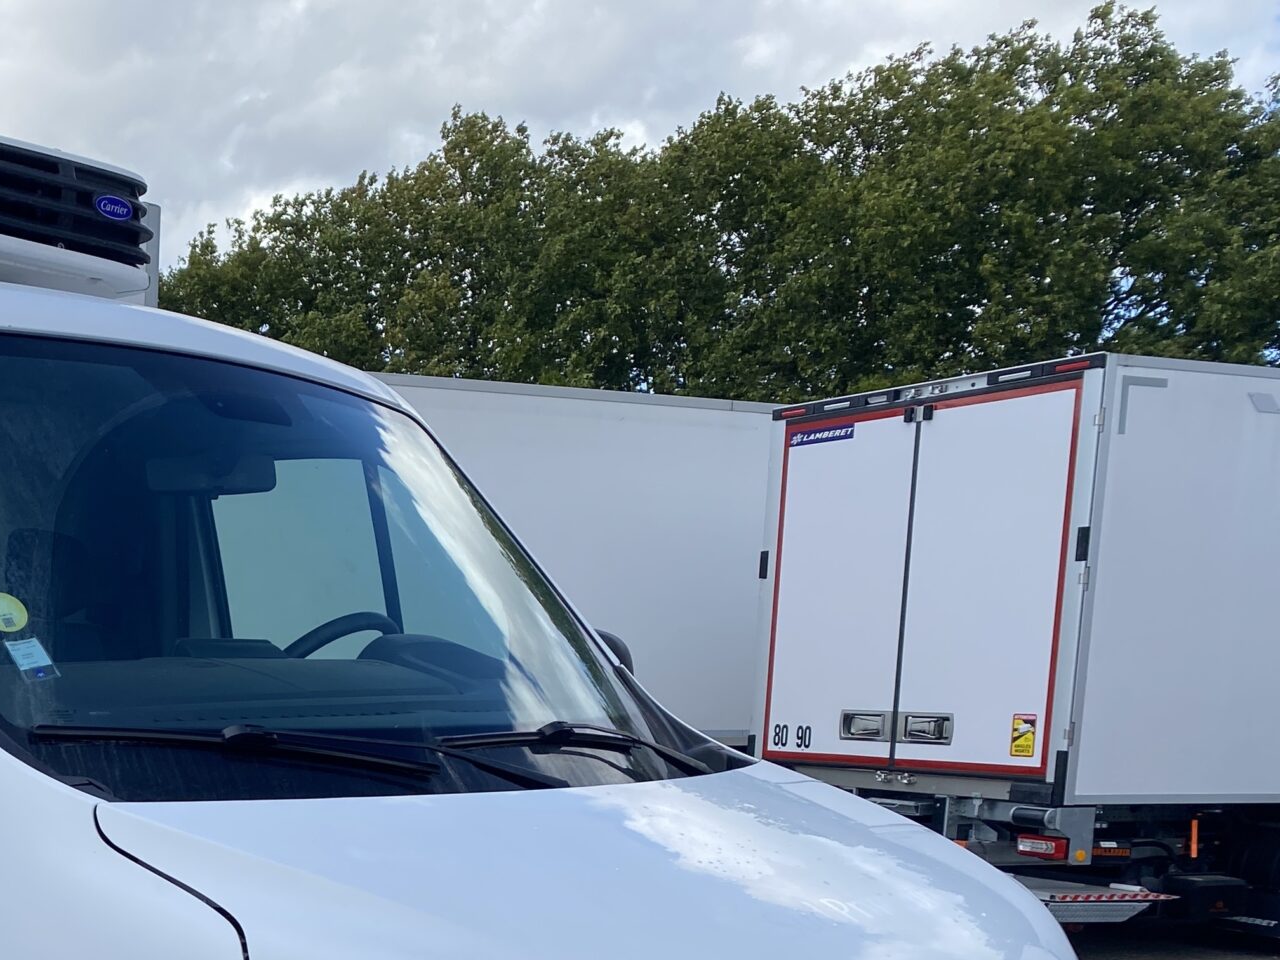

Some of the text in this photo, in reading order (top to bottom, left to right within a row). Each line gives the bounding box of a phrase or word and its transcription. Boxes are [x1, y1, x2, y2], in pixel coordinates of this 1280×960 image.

[100, 200, 128, 215] Carrier
[803, 427, 854, 441] LAMBERET
[773, 723, 812, 749] 80 90
